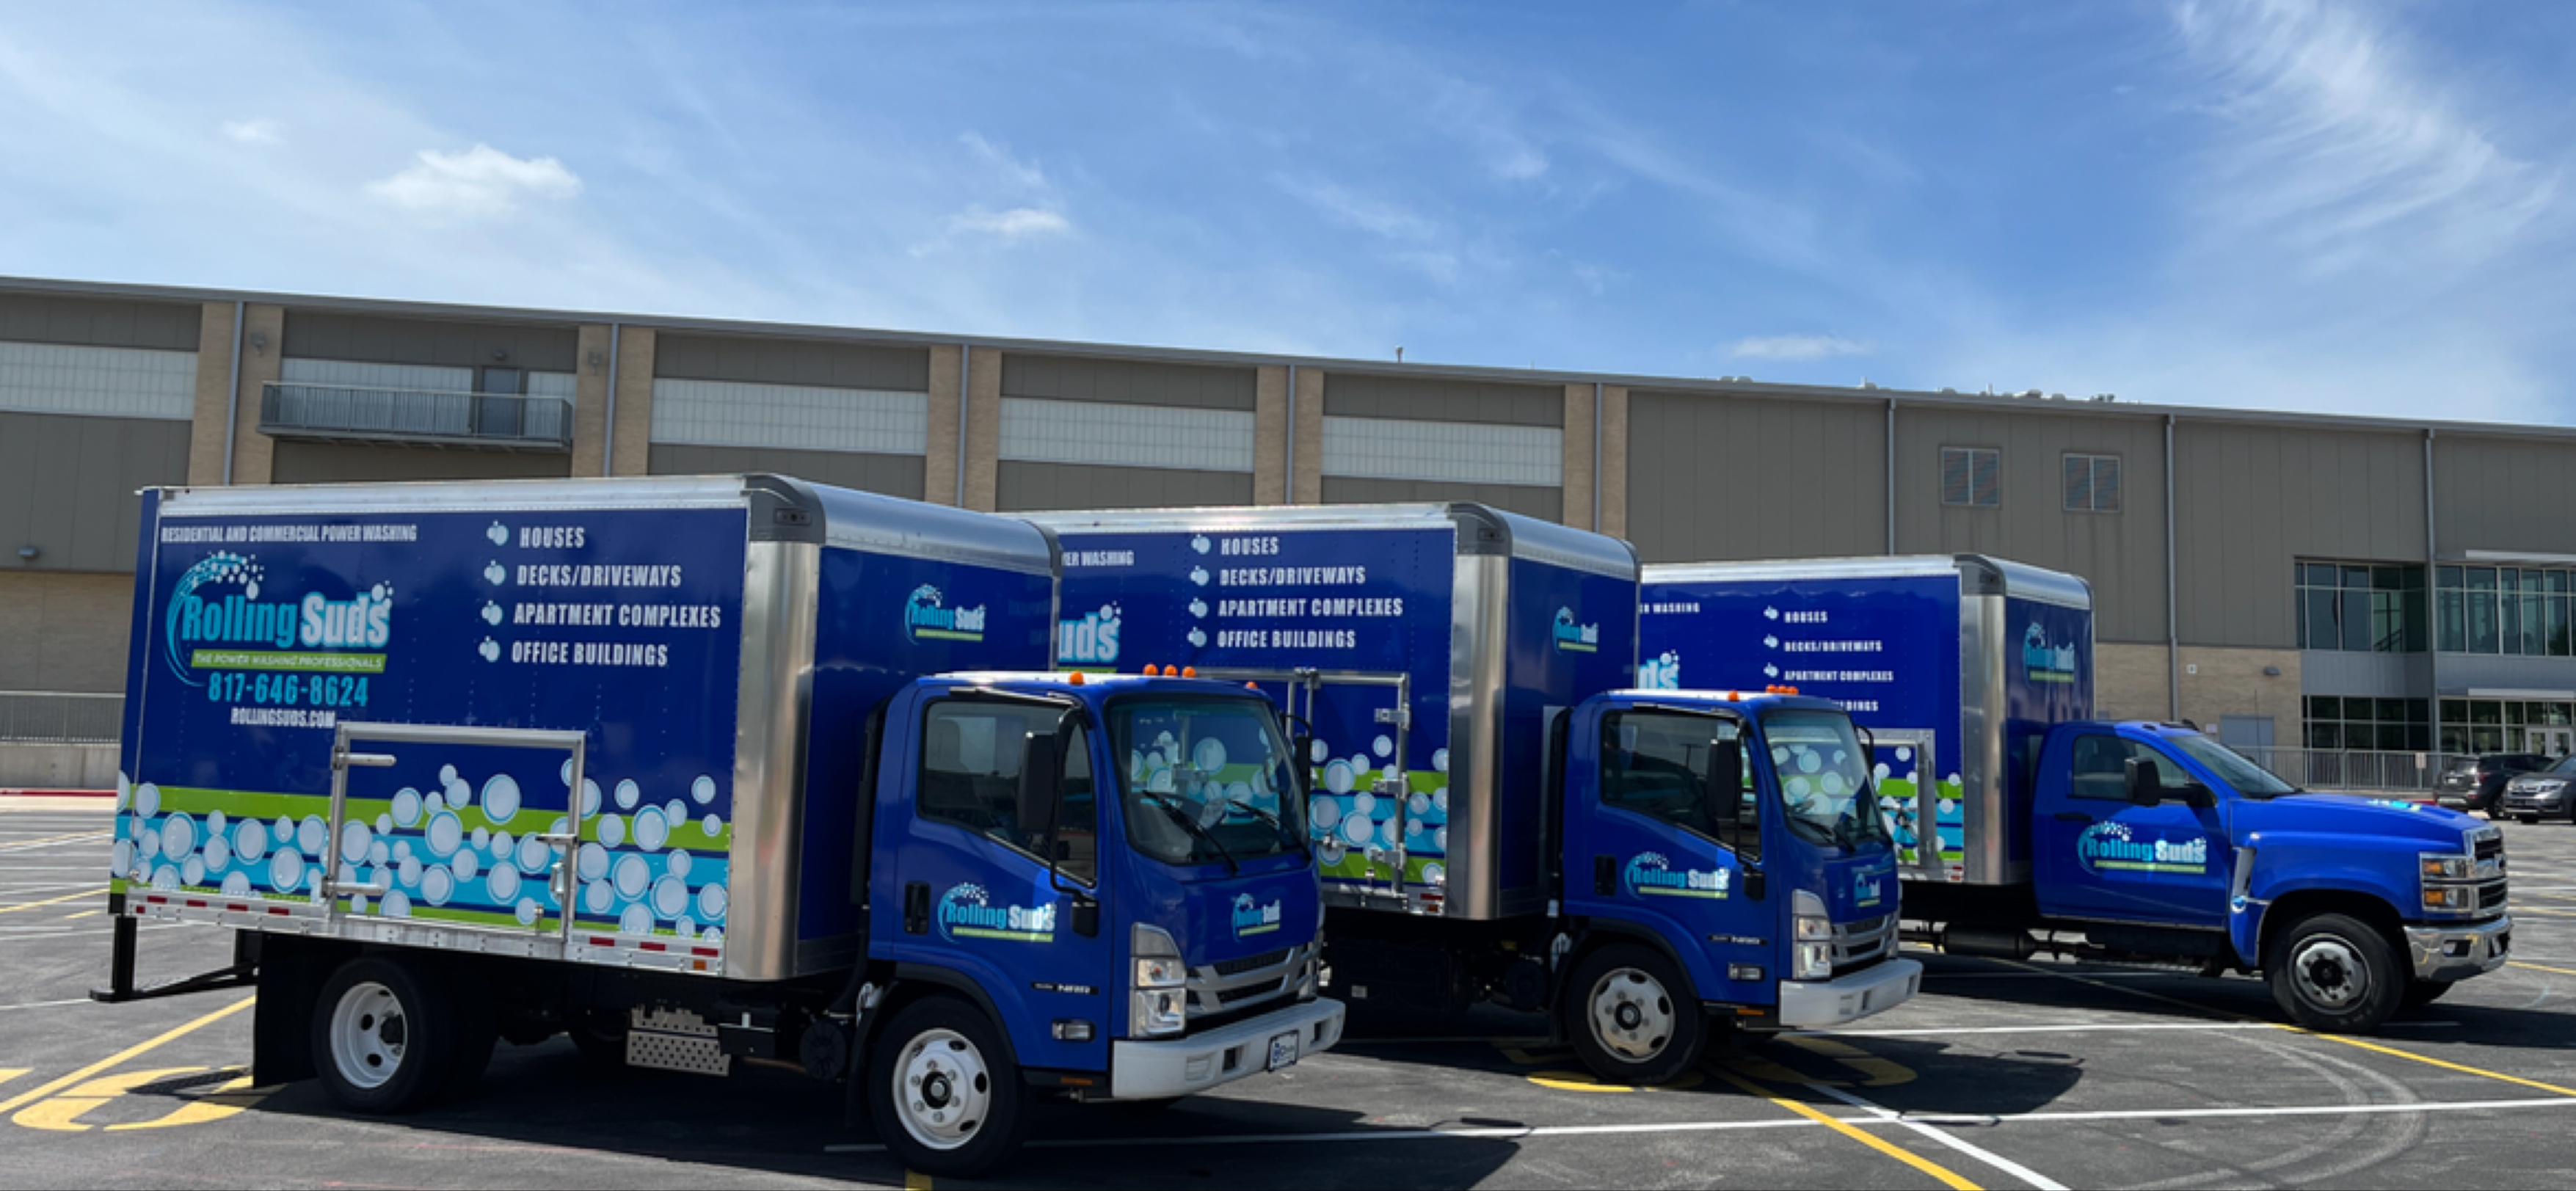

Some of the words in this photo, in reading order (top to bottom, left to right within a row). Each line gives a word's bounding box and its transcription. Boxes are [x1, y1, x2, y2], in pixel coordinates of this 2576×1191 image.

[161, 525, 223, 542] RESIDENTIAL
[226, 525, 247, 542] AND
[249, 525, 319, 542] COMMERCIAL
[321, 525, 361, 542] POWER
[363, 523, 417, 542] WASHING
[519, 527, 586, 548] HOUSES
[1220, 536, 1279, 556] HOUSES
[1081, 550, 1135, 567] WASHING
[517, 564, 683, 587] DECKS/DRIVEWAYS
[1219, 567, 1366, 586] DECKS/DRIVEWAYS
[513, 603, 614, 625] APARTMENT
[618, 605, 721, 628] COMPLEXES
[1217, 598, 1306, 617] APARTMENT
[1311, 597, 1403, 616] COMPLEXES
[183, 594, 298, 648] Rolling
[301, 591, 390, 648] Suds
[1059, 611, 1118, 663] uds
[1217, 631, 1269, 649] OFFICE
[1273, 630, 1356, 649] BUILDINGS
[512, 641, 568, 663] OFFICE
[574, 644, 668, 667] BUILDINGS
[208, 671, 368, 707] 817-646-8624
[230, 707, 336, 729] ROLLINGSUDS.COM
[2086, 839, 2154, 861] Rolling
[2155, 840, 2206, 863] Suds
[946, 902, 1007, 929] Rolling
